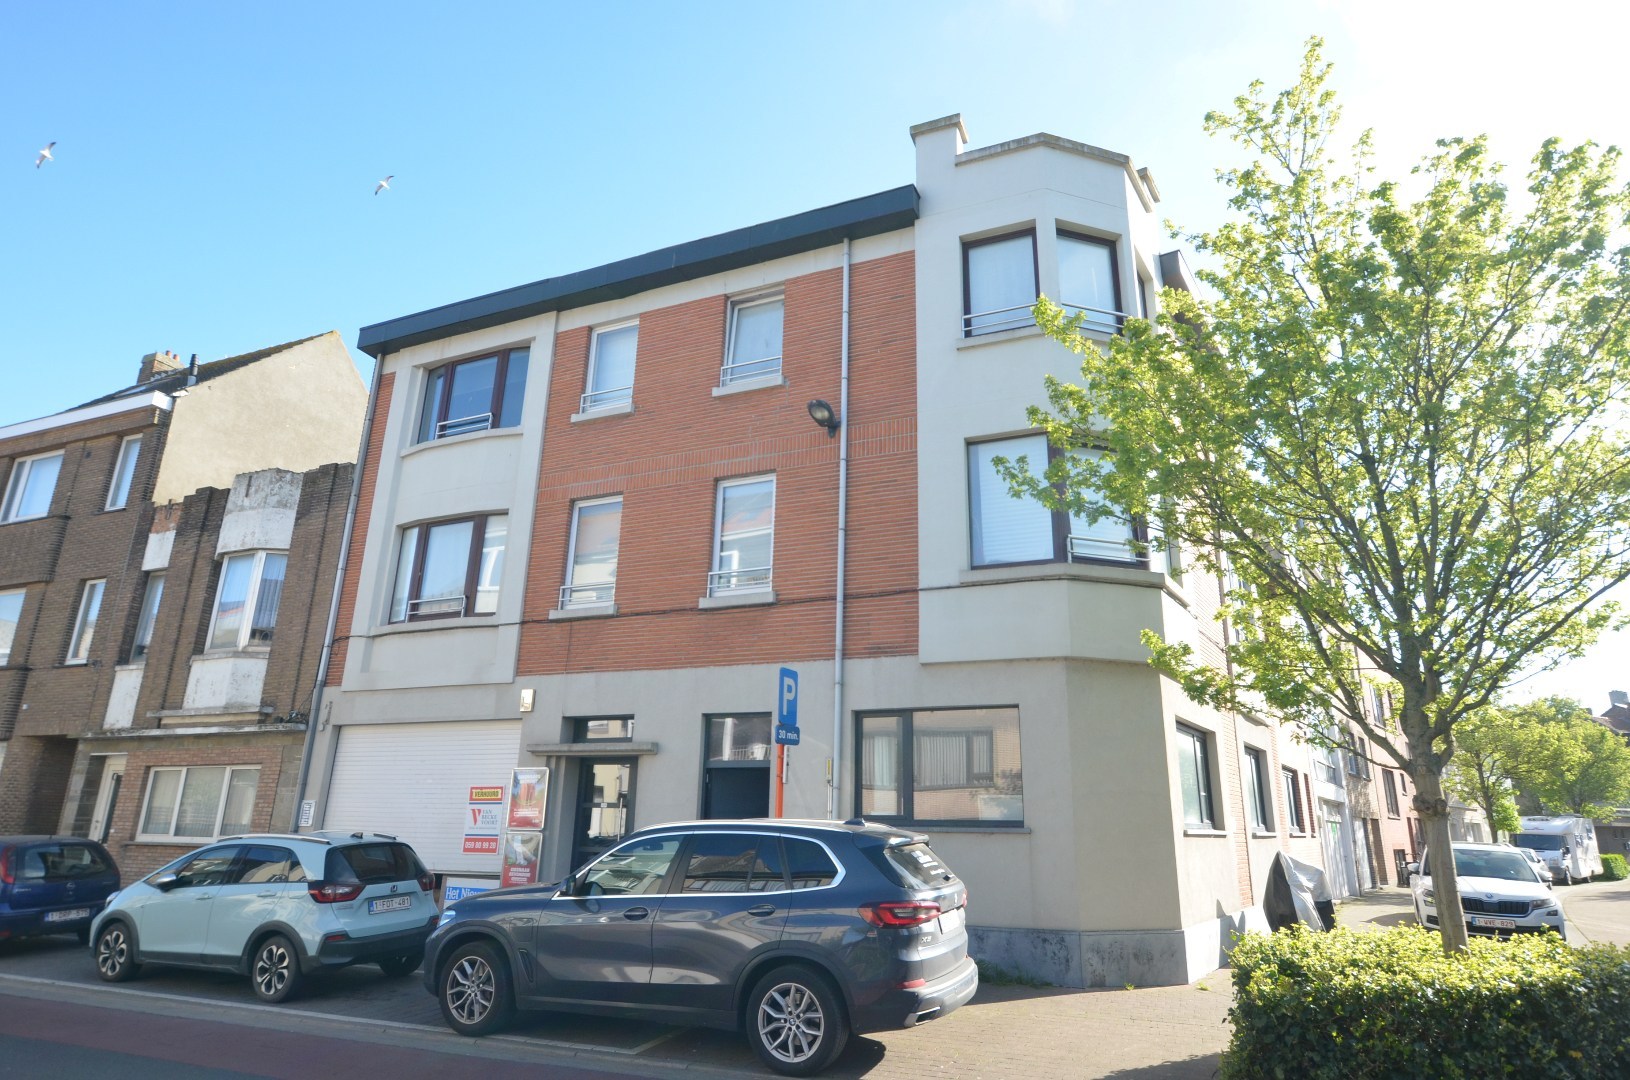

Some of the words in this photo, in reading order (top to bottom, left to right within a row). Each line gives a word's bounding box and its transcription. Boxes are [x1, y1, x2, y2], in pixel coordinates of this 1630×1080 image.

[783, 676, 796, 716] P
[778, 729, 786, 739] 30
[786, 731, 799, 740] min.
[445, 887, 460, 900] Het
